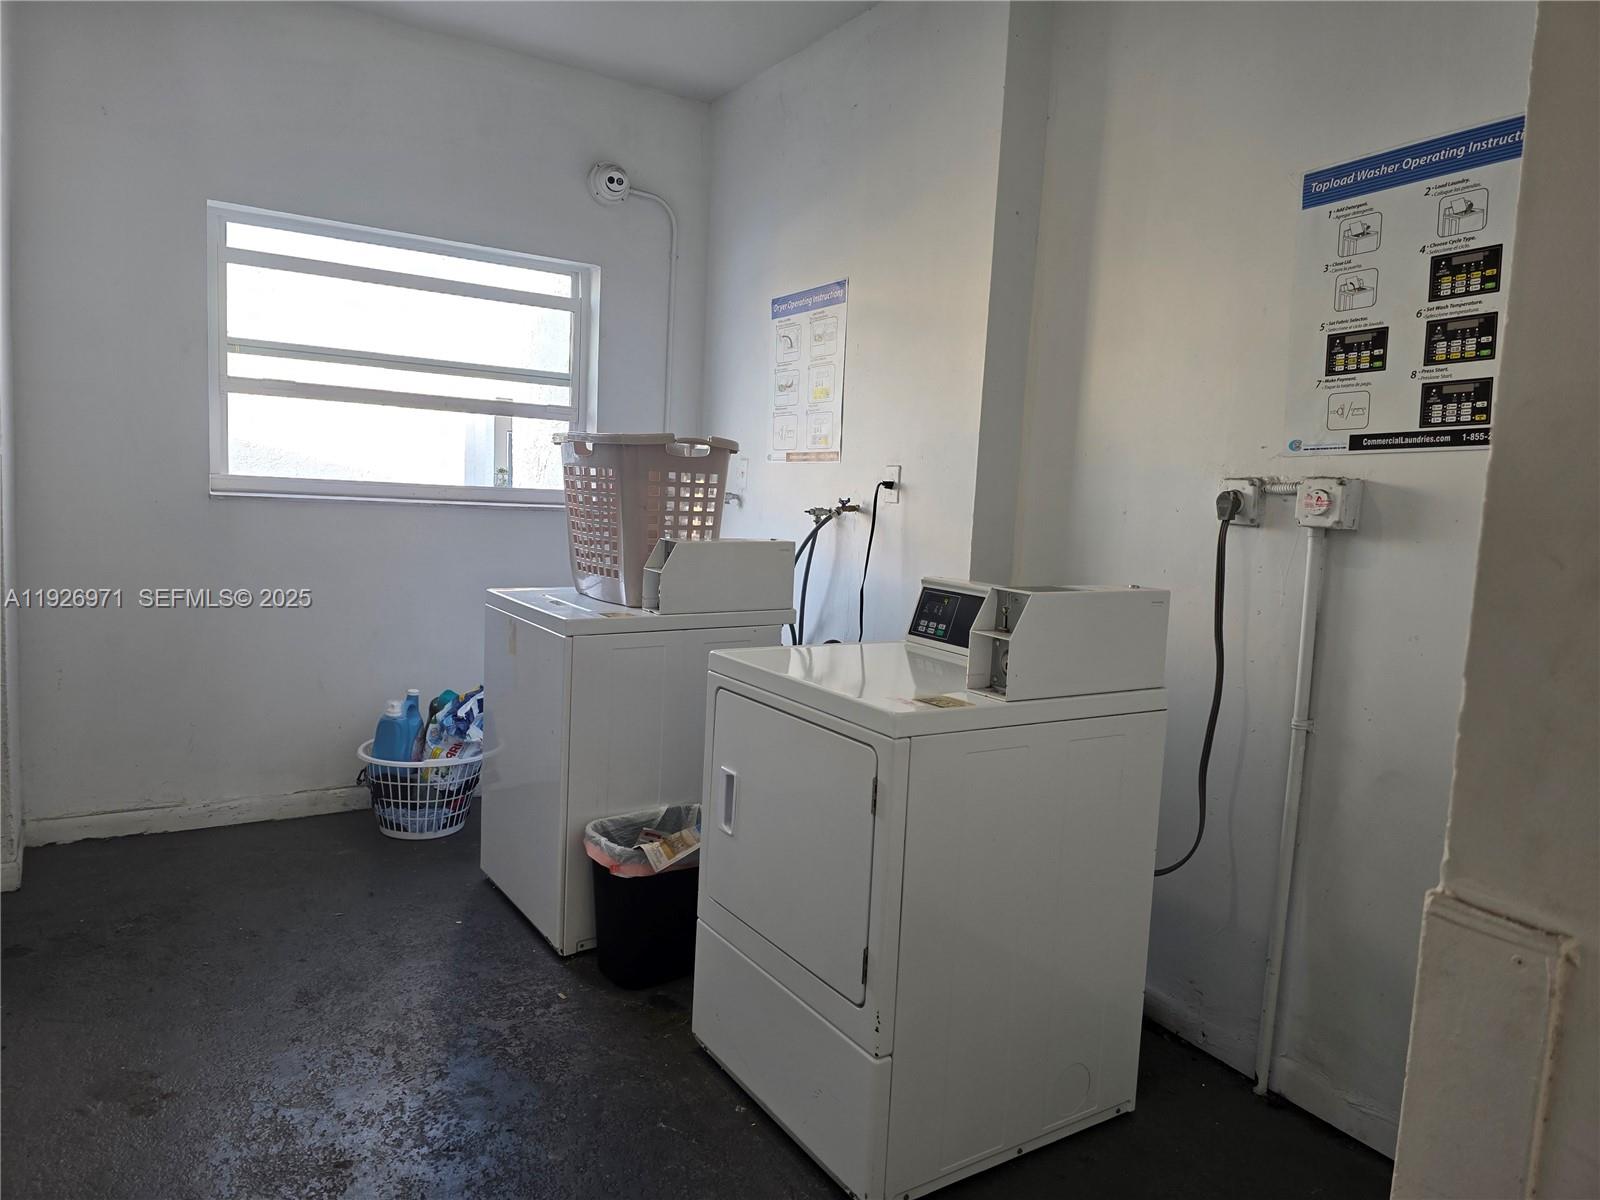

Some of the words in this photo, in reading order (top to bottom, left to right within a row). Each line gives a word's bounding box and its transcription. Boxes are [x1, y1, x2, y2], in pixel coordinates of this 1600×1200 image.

[1311, 172, 1355, 194] Topload
[1356, 161, 1400, 181] Washer
[1402, 145, 1466, 171] Operating
[1423, 186, 1431, 197] 2
[1419, 245, 1426, 254] 4
[1448, 238, 1463, 246] Cycle
[1323, 264, 1329, 273] 3
[1416, 309, 1423, 319] 6
[1319, 322, 1326, 332] 5
[1410, 370, 1417, 379] 8
[1315, 379, 1322, 389] 7
[1362, 434, 1451, 446] CommercialLaundries.com
